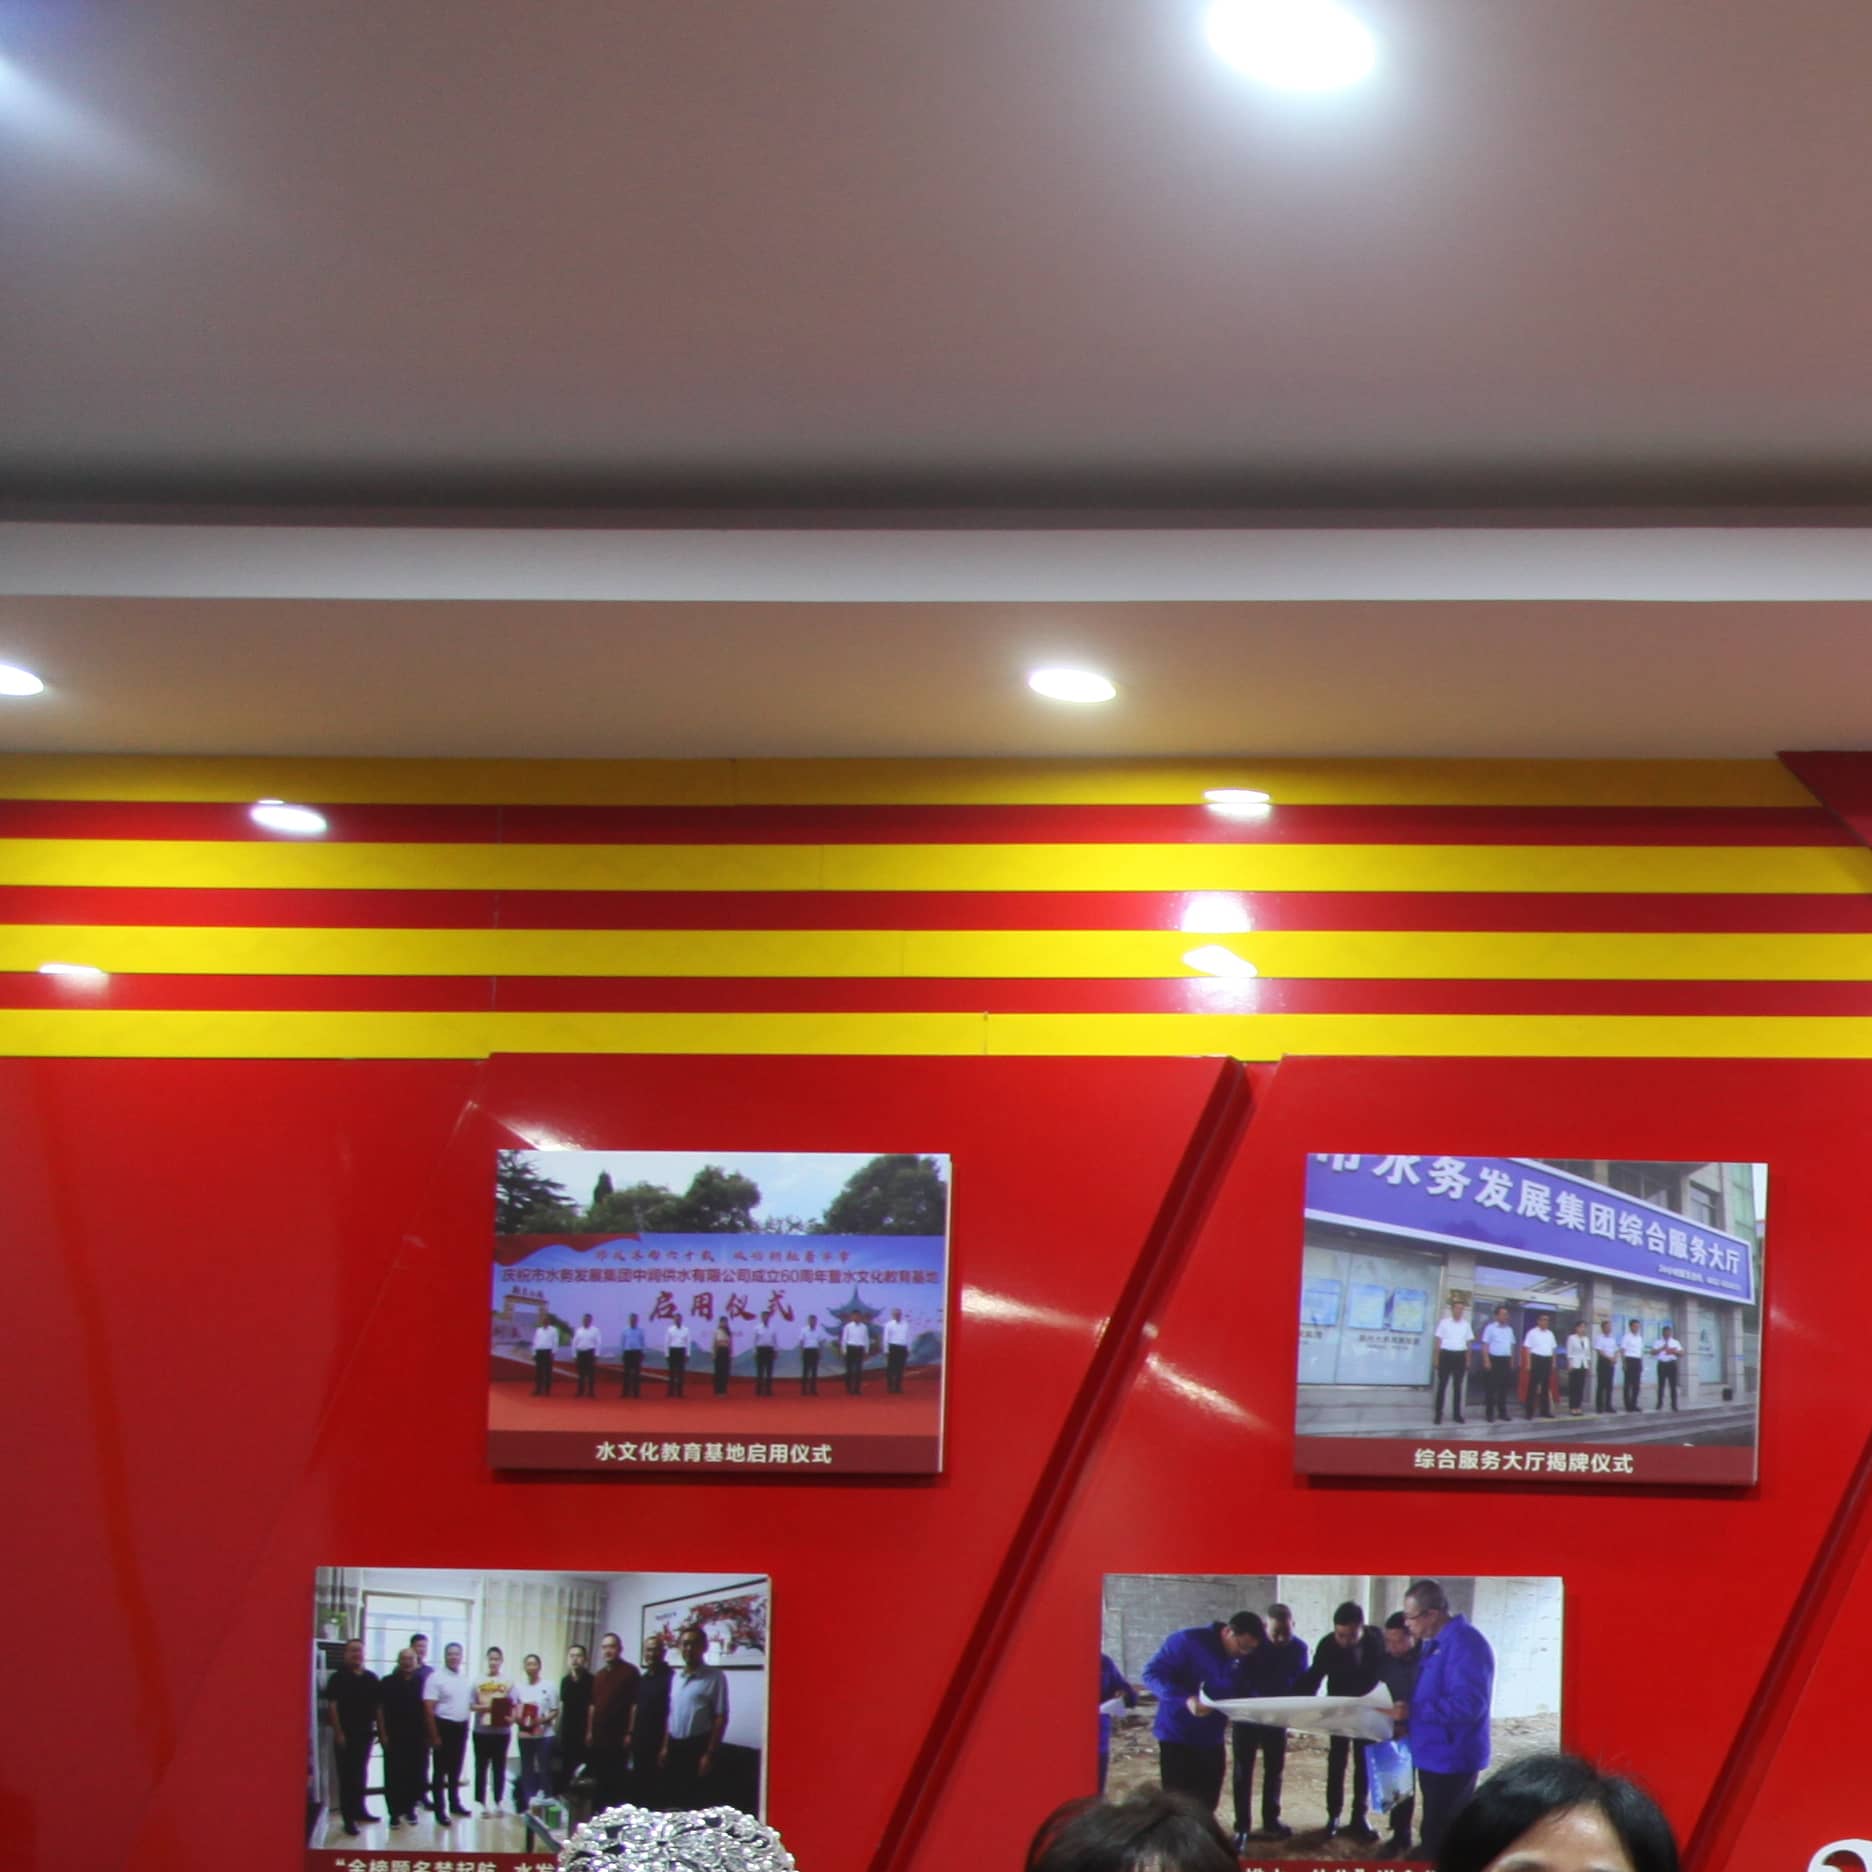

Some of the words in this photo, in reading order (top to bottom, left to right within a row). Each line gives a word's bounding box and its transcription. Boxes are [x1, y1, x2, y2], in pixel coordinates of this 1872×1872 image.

[595, 1440, 832, 1465] 水文化教育基地启用仪式
[1414, 1447, 1635, 1475] 综合服务大厅揭牌仪式
